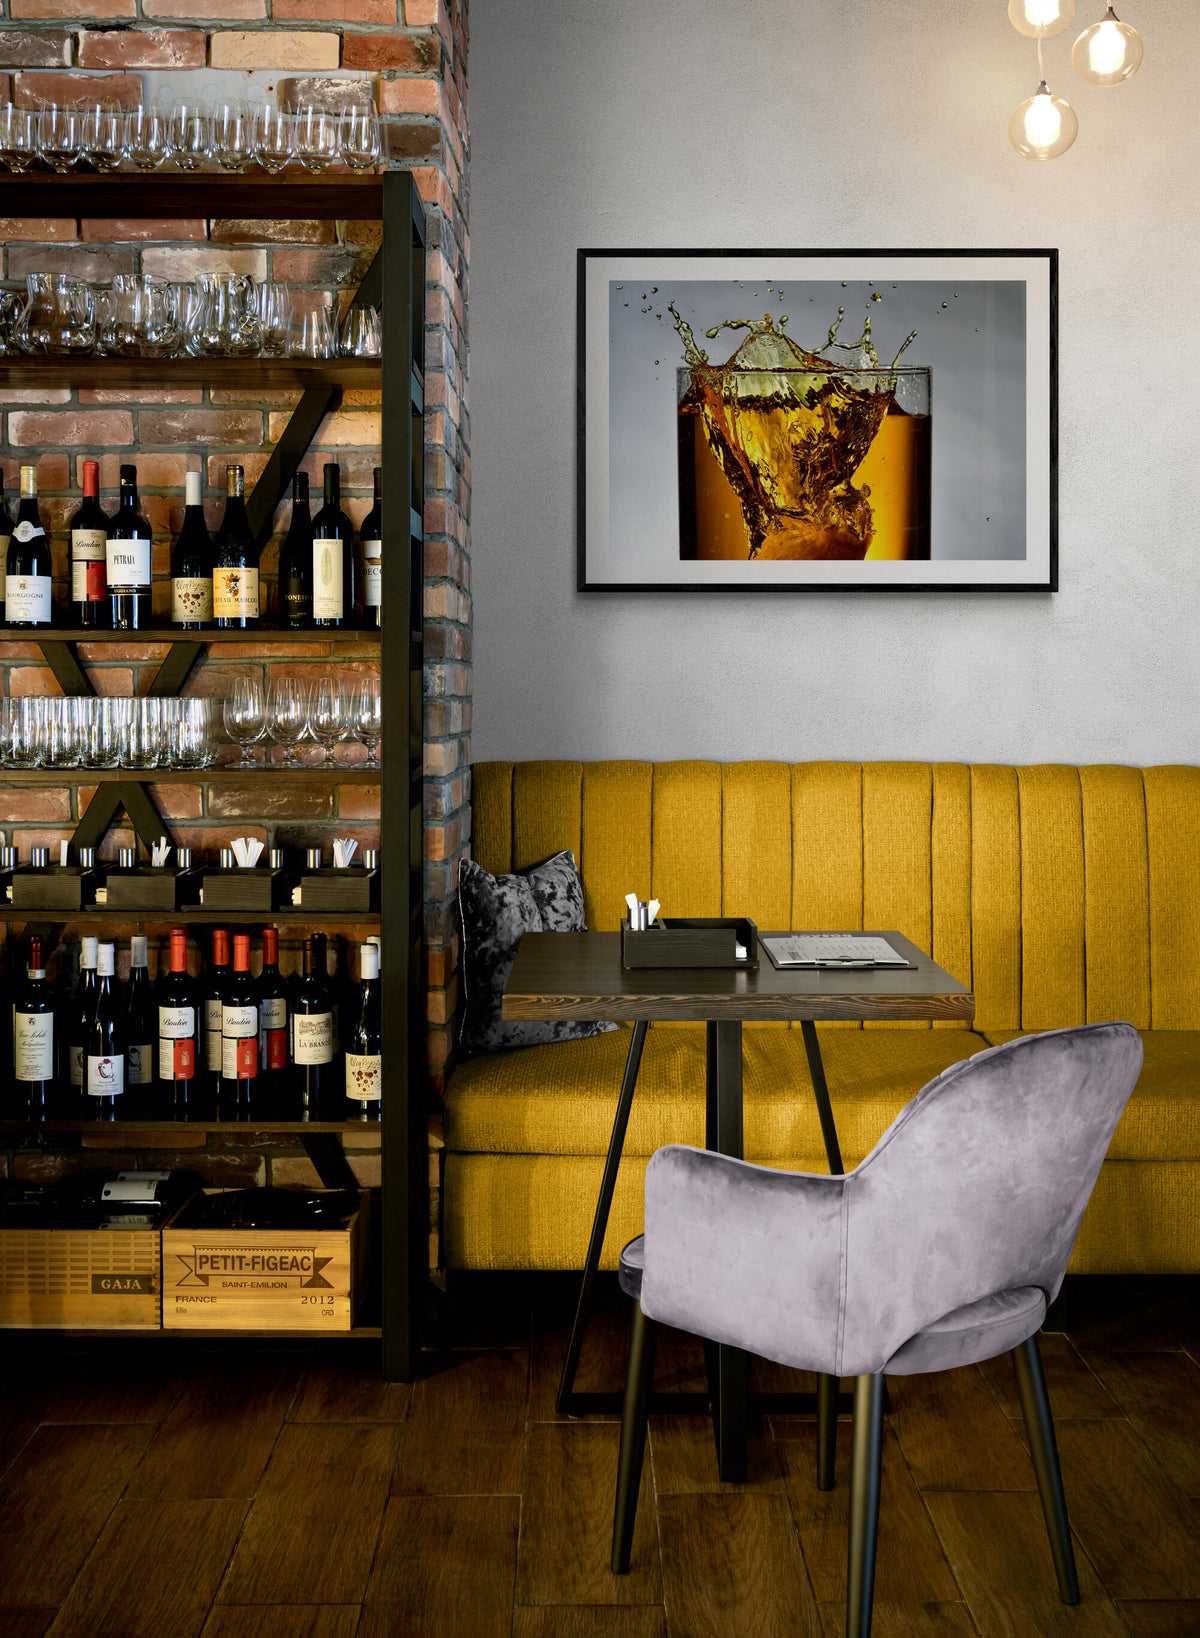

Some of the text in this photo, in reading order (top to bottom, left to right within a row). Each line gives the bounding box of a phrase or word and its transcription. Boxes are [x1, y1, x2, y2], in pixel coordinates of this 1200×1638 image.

[113, 555, 135, 565] PETRAIA
[199, 1255, 311, 1272] PETIT-FIGEAC
[101, 1279, 143, 1290] GAJA
[222, 1281, 288, 1289] SAINT-EMILION
[175, 1295, 217, 1303] FRANCE
[301, 1295, 335, 1304] 2012
